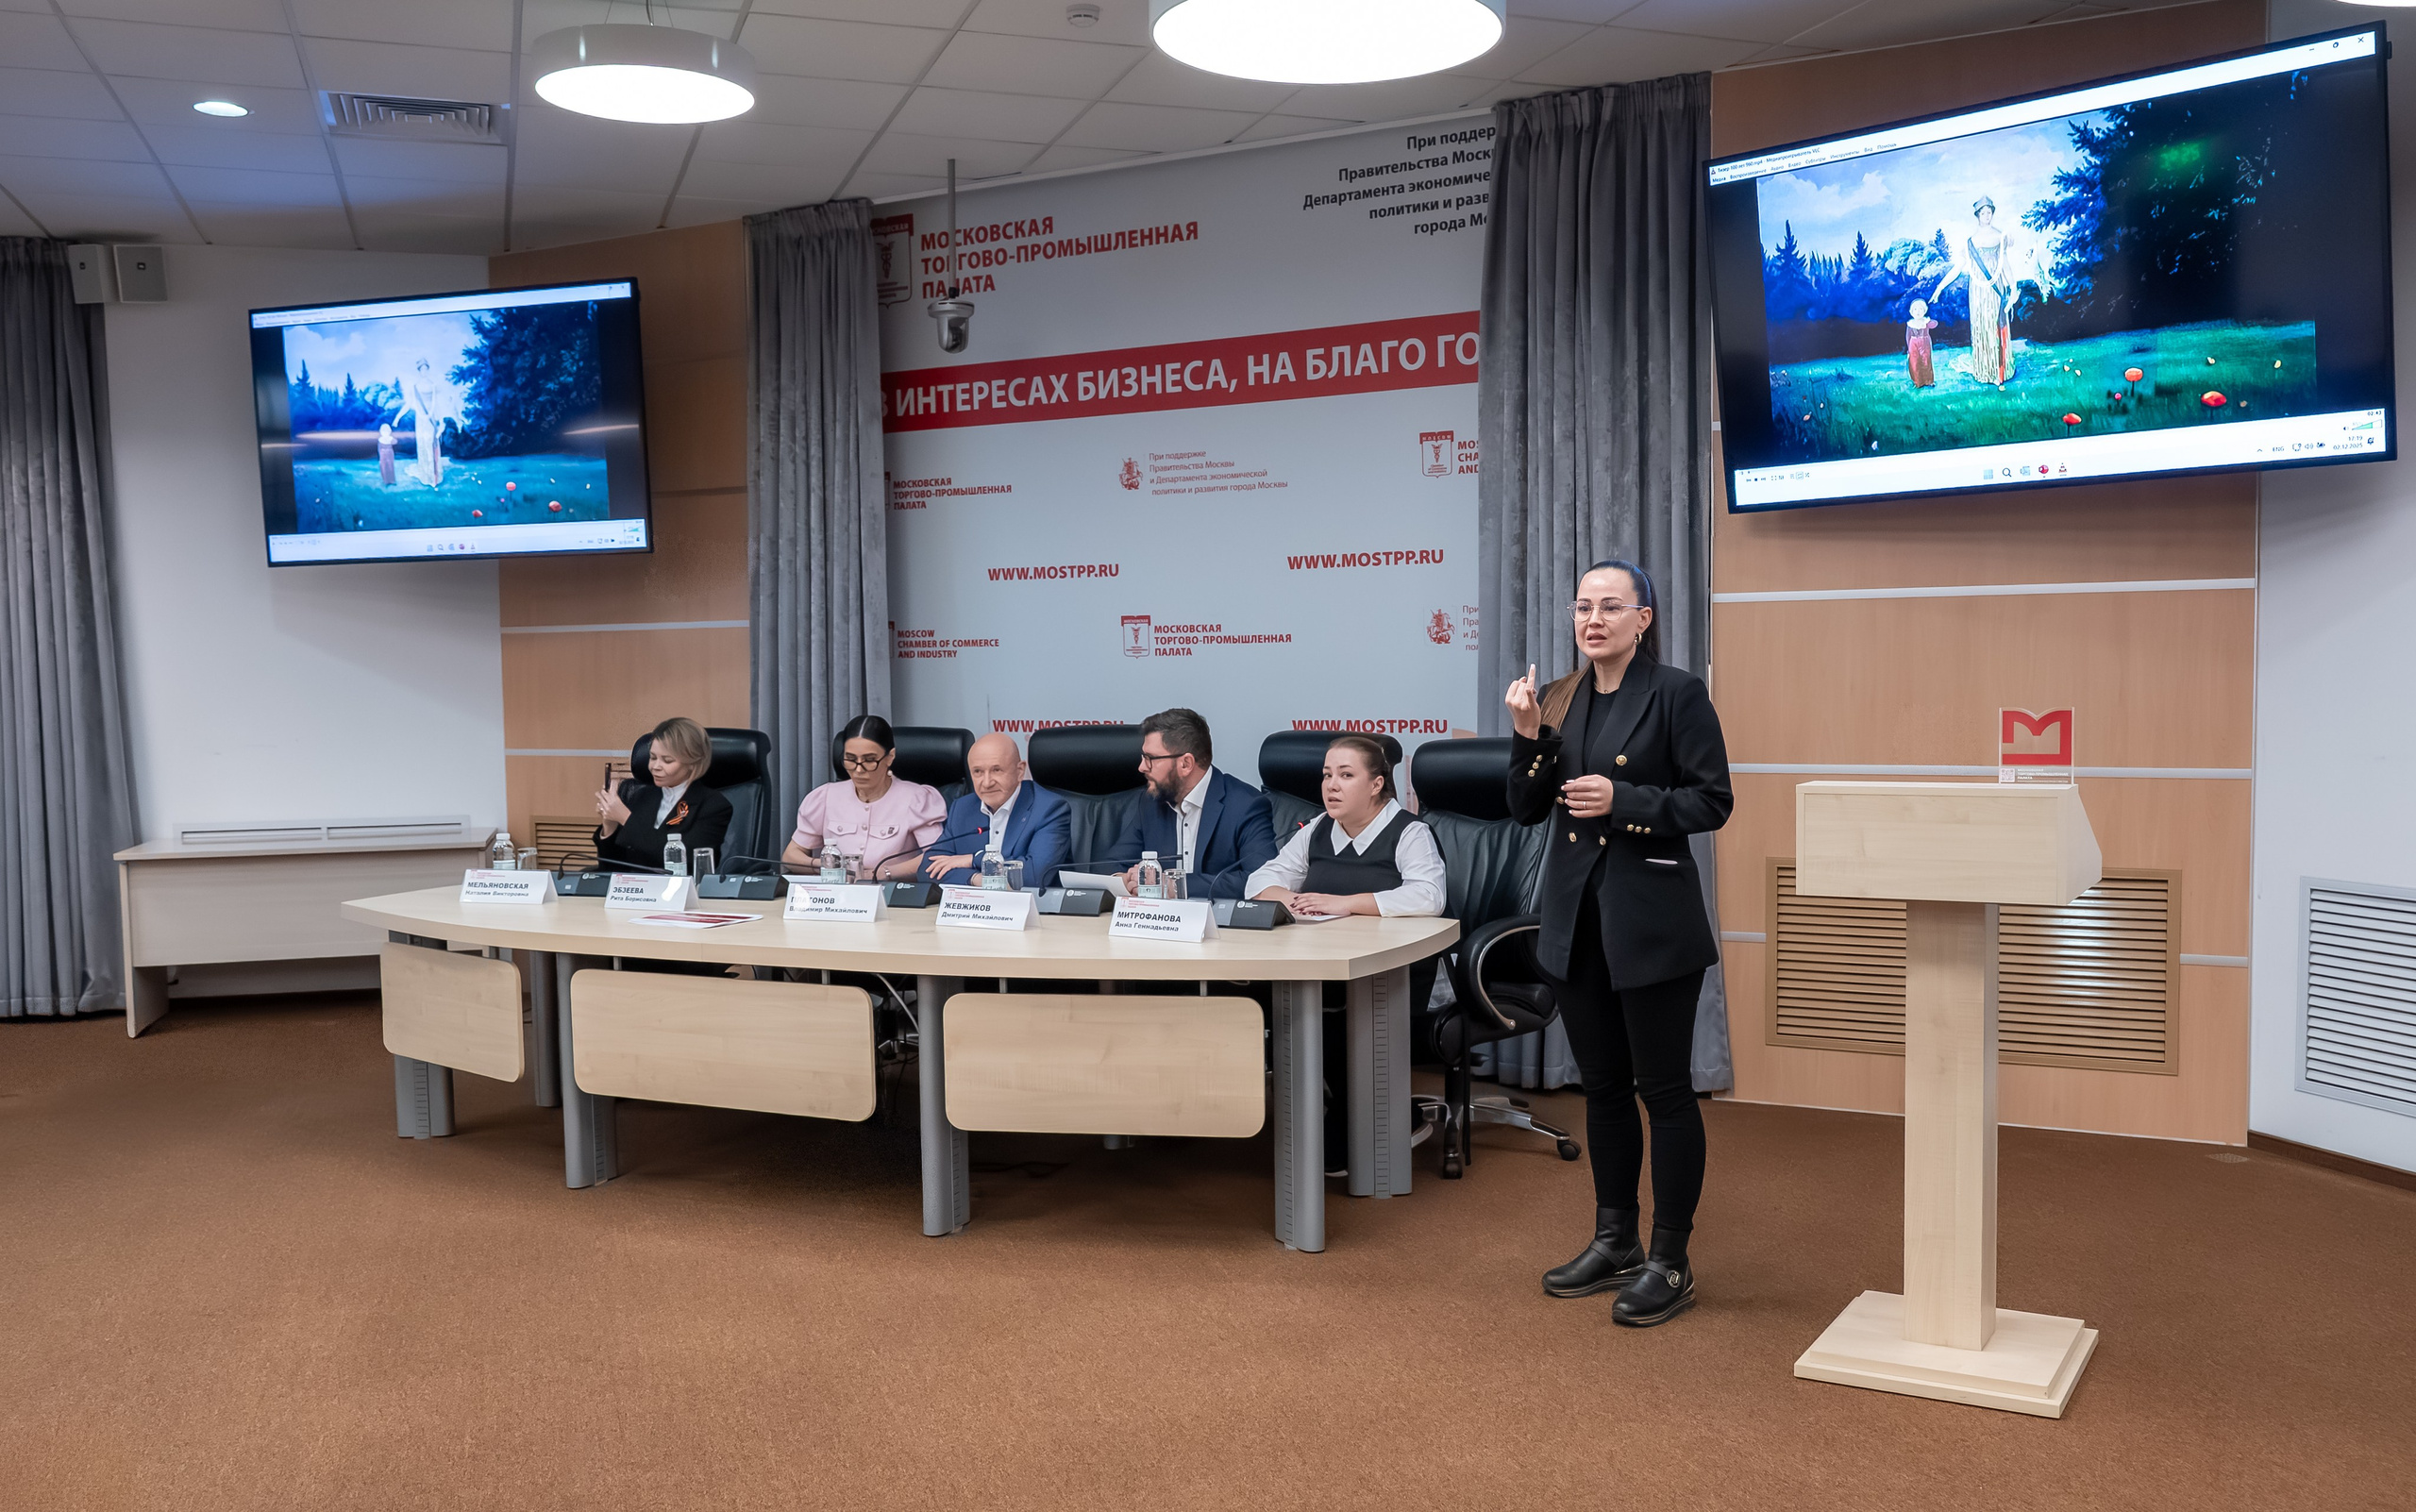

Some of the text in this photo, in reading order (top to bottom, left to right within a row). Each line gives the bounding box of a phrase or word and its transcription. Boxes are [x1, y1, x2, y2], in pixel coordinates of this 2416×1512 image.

[1406, 135, 1436, 152] При
[1338, 148, 1494, 183] Правительства Моск
[1303, 171, 1491, 210] Департамента экономиче
[1369, 199, 1439, 219] политики
[1443, 197, 1451, 209] и
[1415, 216, 1466, 235] города
[921, 216, 1053, 251] МОСКОВСКАЯ
[896, 373, 1068, 416] ИНТЕРЕСАХ
[1077, 359, 1237, 402] БИЗНЕСА,
[1247, 352, 1296, 386] НА
[1306, 338, 1426, 380] БЛАГО
[1437, 332, 1480, 367] ГО
[1457, 440, 1478, 450] MO
[1149, 450, 1206, 462] При поддержке
[1149, 461, 1234, 474] Правительства Москвы
[893, 478, 951, 489] МОСКОВСКАЯ
[1156, 474, 1208, 485] Департамента
[1209, 469, 1268, 481] экономической
[893, 485, 1012, 499] ТОРГОВО-ПРОМЫШЛЕННАЯ
[1151, 487, 1186, 496] политики
[1194, 484, 1228, 496] развития
[1230, 482, 1256, 493] города
[1257, 480, 1288, 490] Москвы
[894, 501, 927, 510] ПАЛАТА
[1287, 548, 1444, 570] WWW.MOSTPP.RU
[988, 563, 1119, 581] WWW.MOSTPP.RU
[898, 630, 935, 638] MOSCOW
[1154, 624, 1222, 634] МОСКОВСКАЯ
[952, 639, 999, 647] COMMERCE
[1154, 633, 1292, 646] ТОРГОВО-ПРОМЫШЛЕННАЯ
[1154, 647, 1192, 656] ПАЛАТА
[1292, 719, 1448, 734] WWWMOSTPP.RU
[467, 882, 529, 890] МЕЛЬЯНОВСКАЯ
[944, 902, 991, 912] ЖЕВЖИКОВ
[971, 914, 1014, 922] Михайлович
[1117, 911, 1182, 923] МИТРОФАНОВА
[1133, 922, 1179, 932] Геннадьевна
